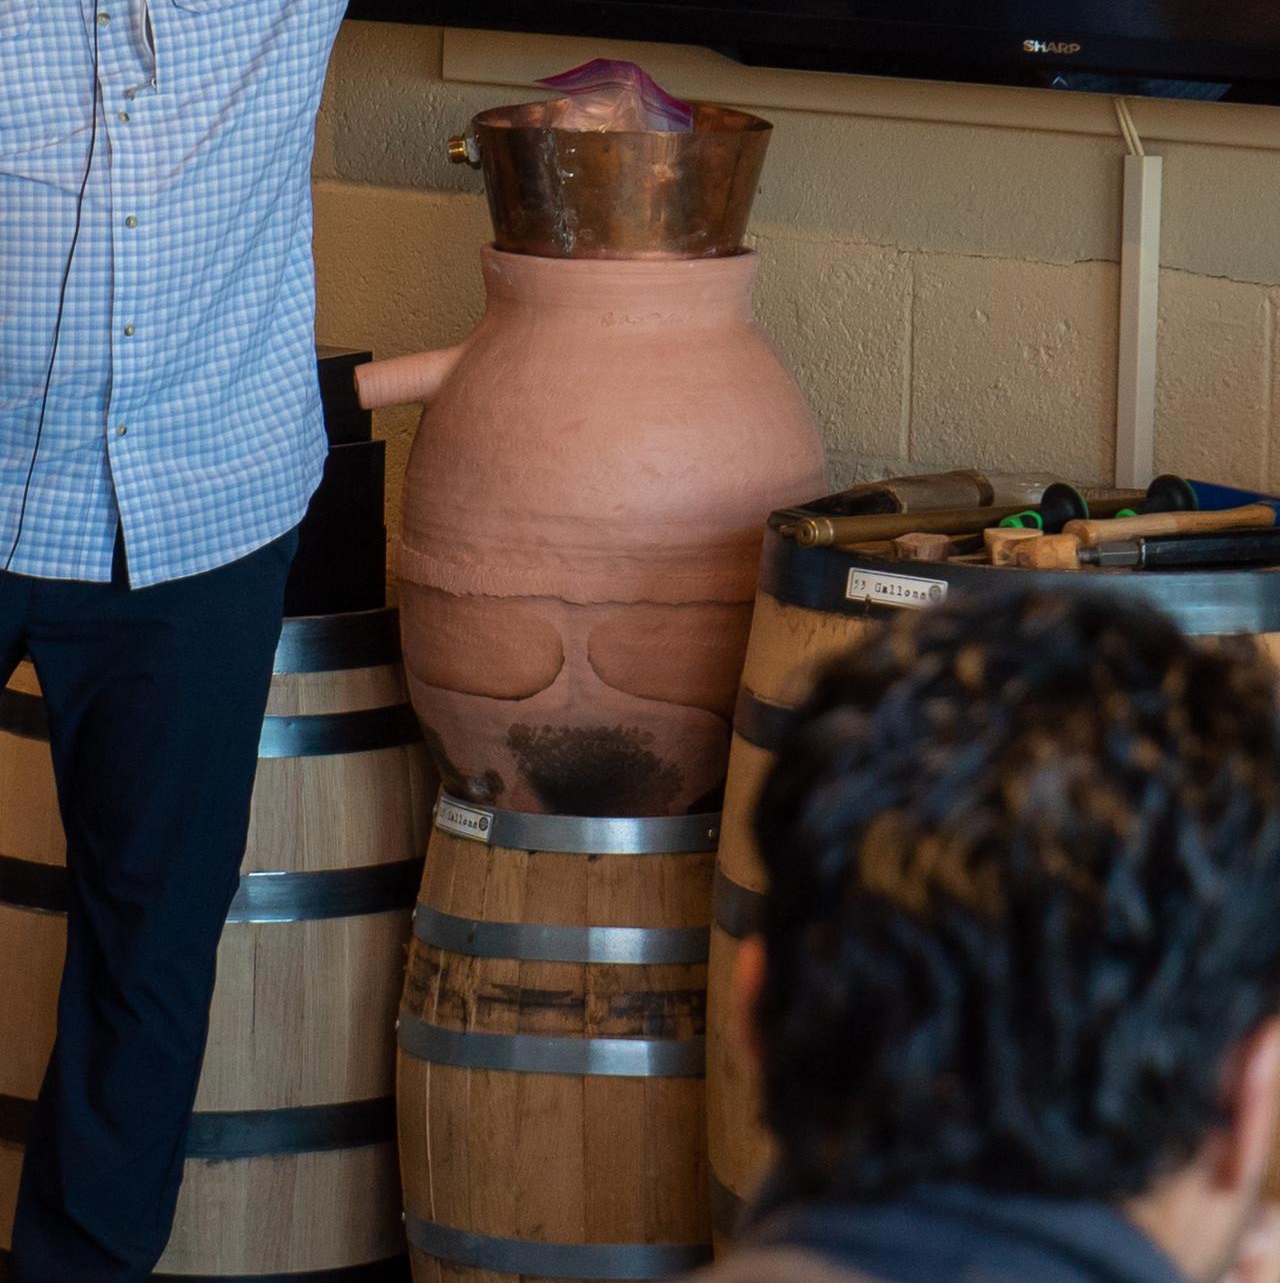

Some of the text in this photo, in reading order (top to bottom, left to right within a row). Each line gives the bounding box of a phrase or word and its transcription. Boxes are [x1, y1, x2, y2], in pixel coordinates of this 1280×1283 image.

[1023, 39, 1081, 54] SHARP
[853, 578, 926, 599] 53 Gallons
